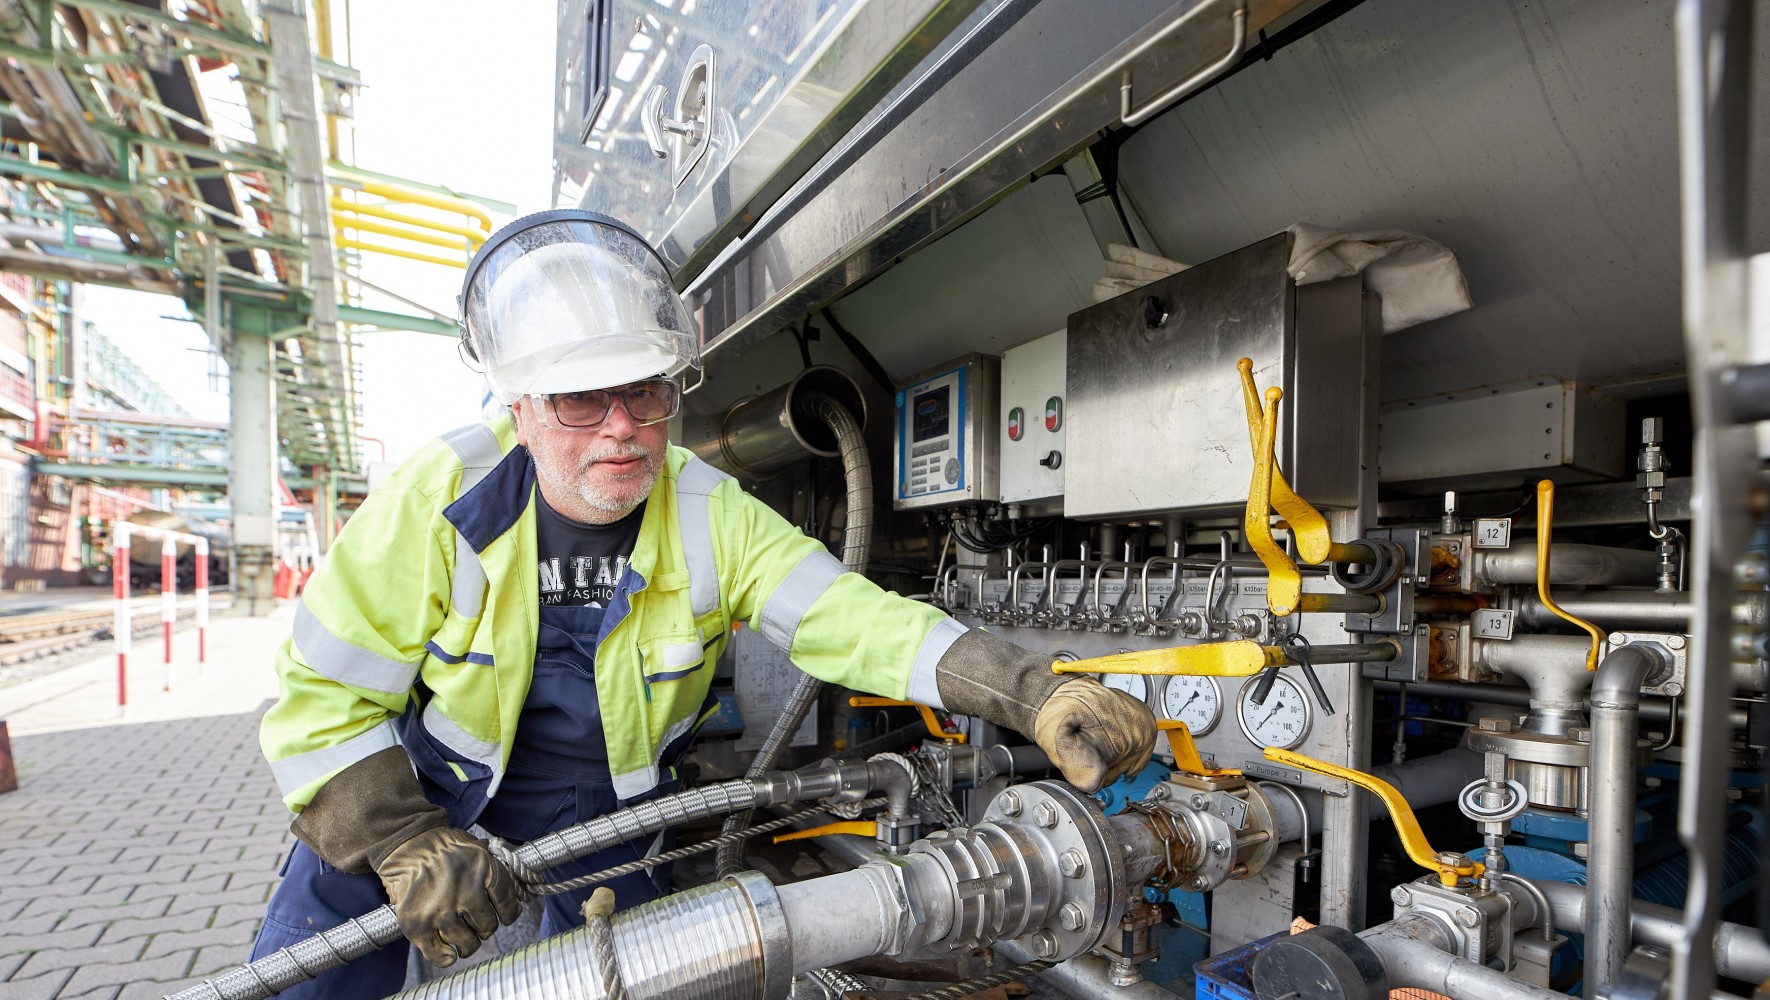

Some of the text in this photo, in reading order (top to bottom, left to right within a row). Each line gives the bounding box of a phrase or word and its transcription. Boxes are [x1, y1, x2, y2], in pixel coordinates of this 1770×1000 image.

[1487, 528, 1499, 539] 12
[567, 587, 614, 601] FASHIO
[1490, 618, 1502, 630] 13
[1279, 690, 1287, 698] 60
[1290, 706, 1297, 714] 80
[1283, 723, 1293, 731] 100
[1256, 765, 1280, 777] Pumpe
[1230, 806, 1235, 817] 1
